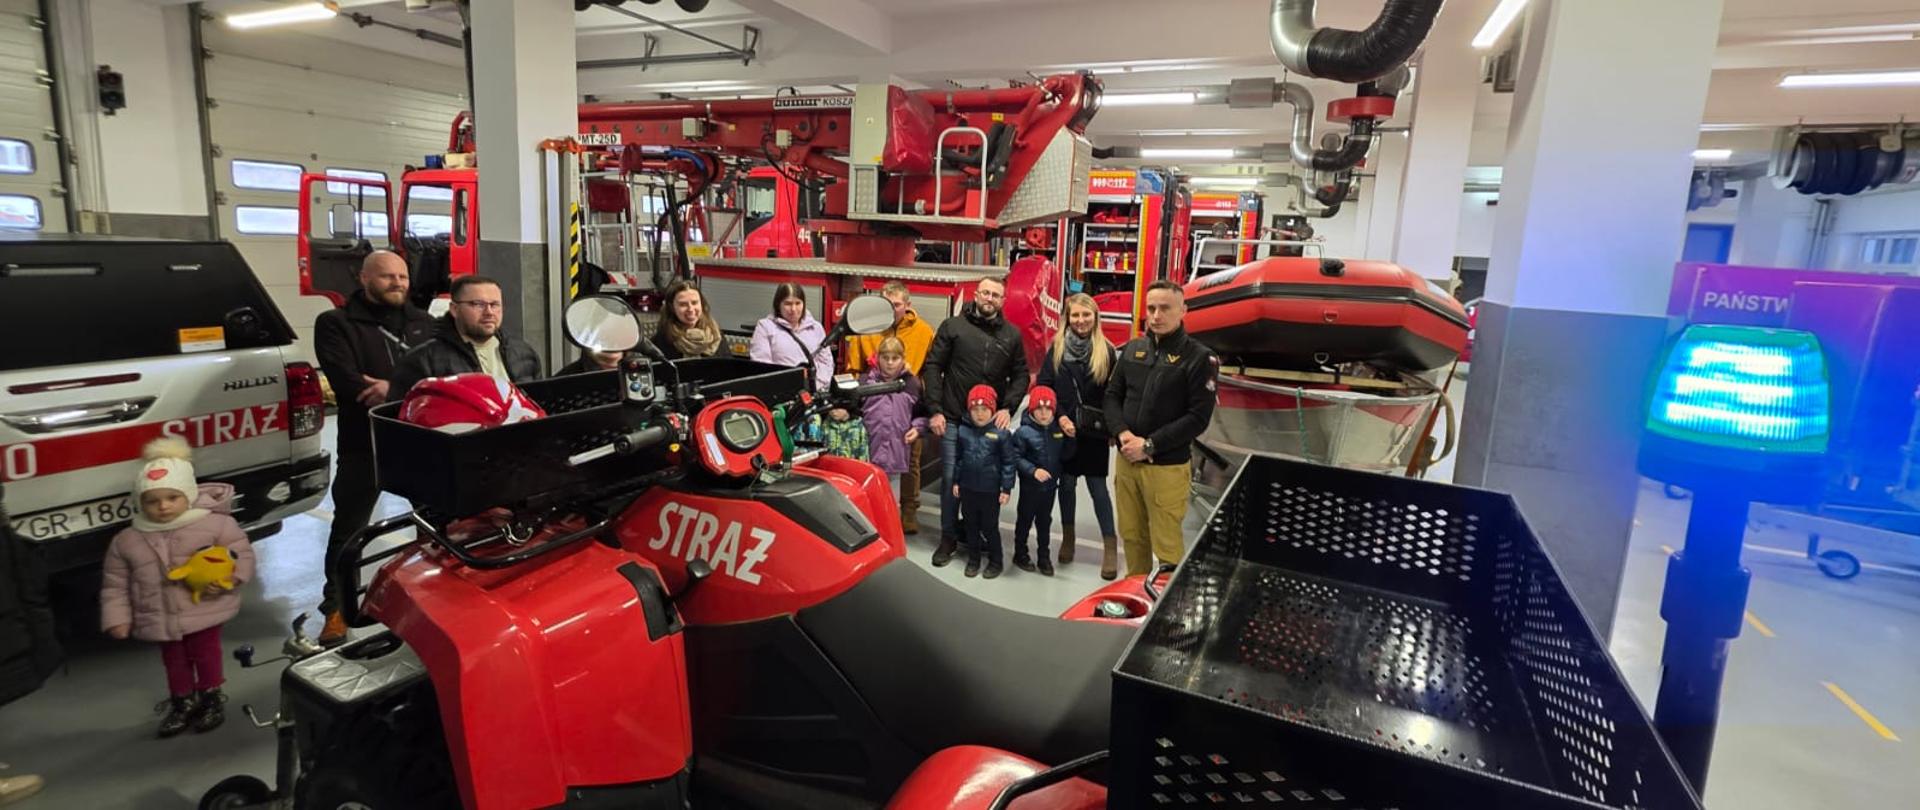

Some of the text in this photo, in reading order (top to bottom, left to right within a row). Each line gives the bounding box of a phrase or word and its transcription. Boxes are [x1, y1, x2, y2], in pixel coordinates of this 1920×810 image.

[223, 376, 279, 391] HILUX
[81, 499, 139, 526] 186
[648, 501, 776, 585] STRAŻ
